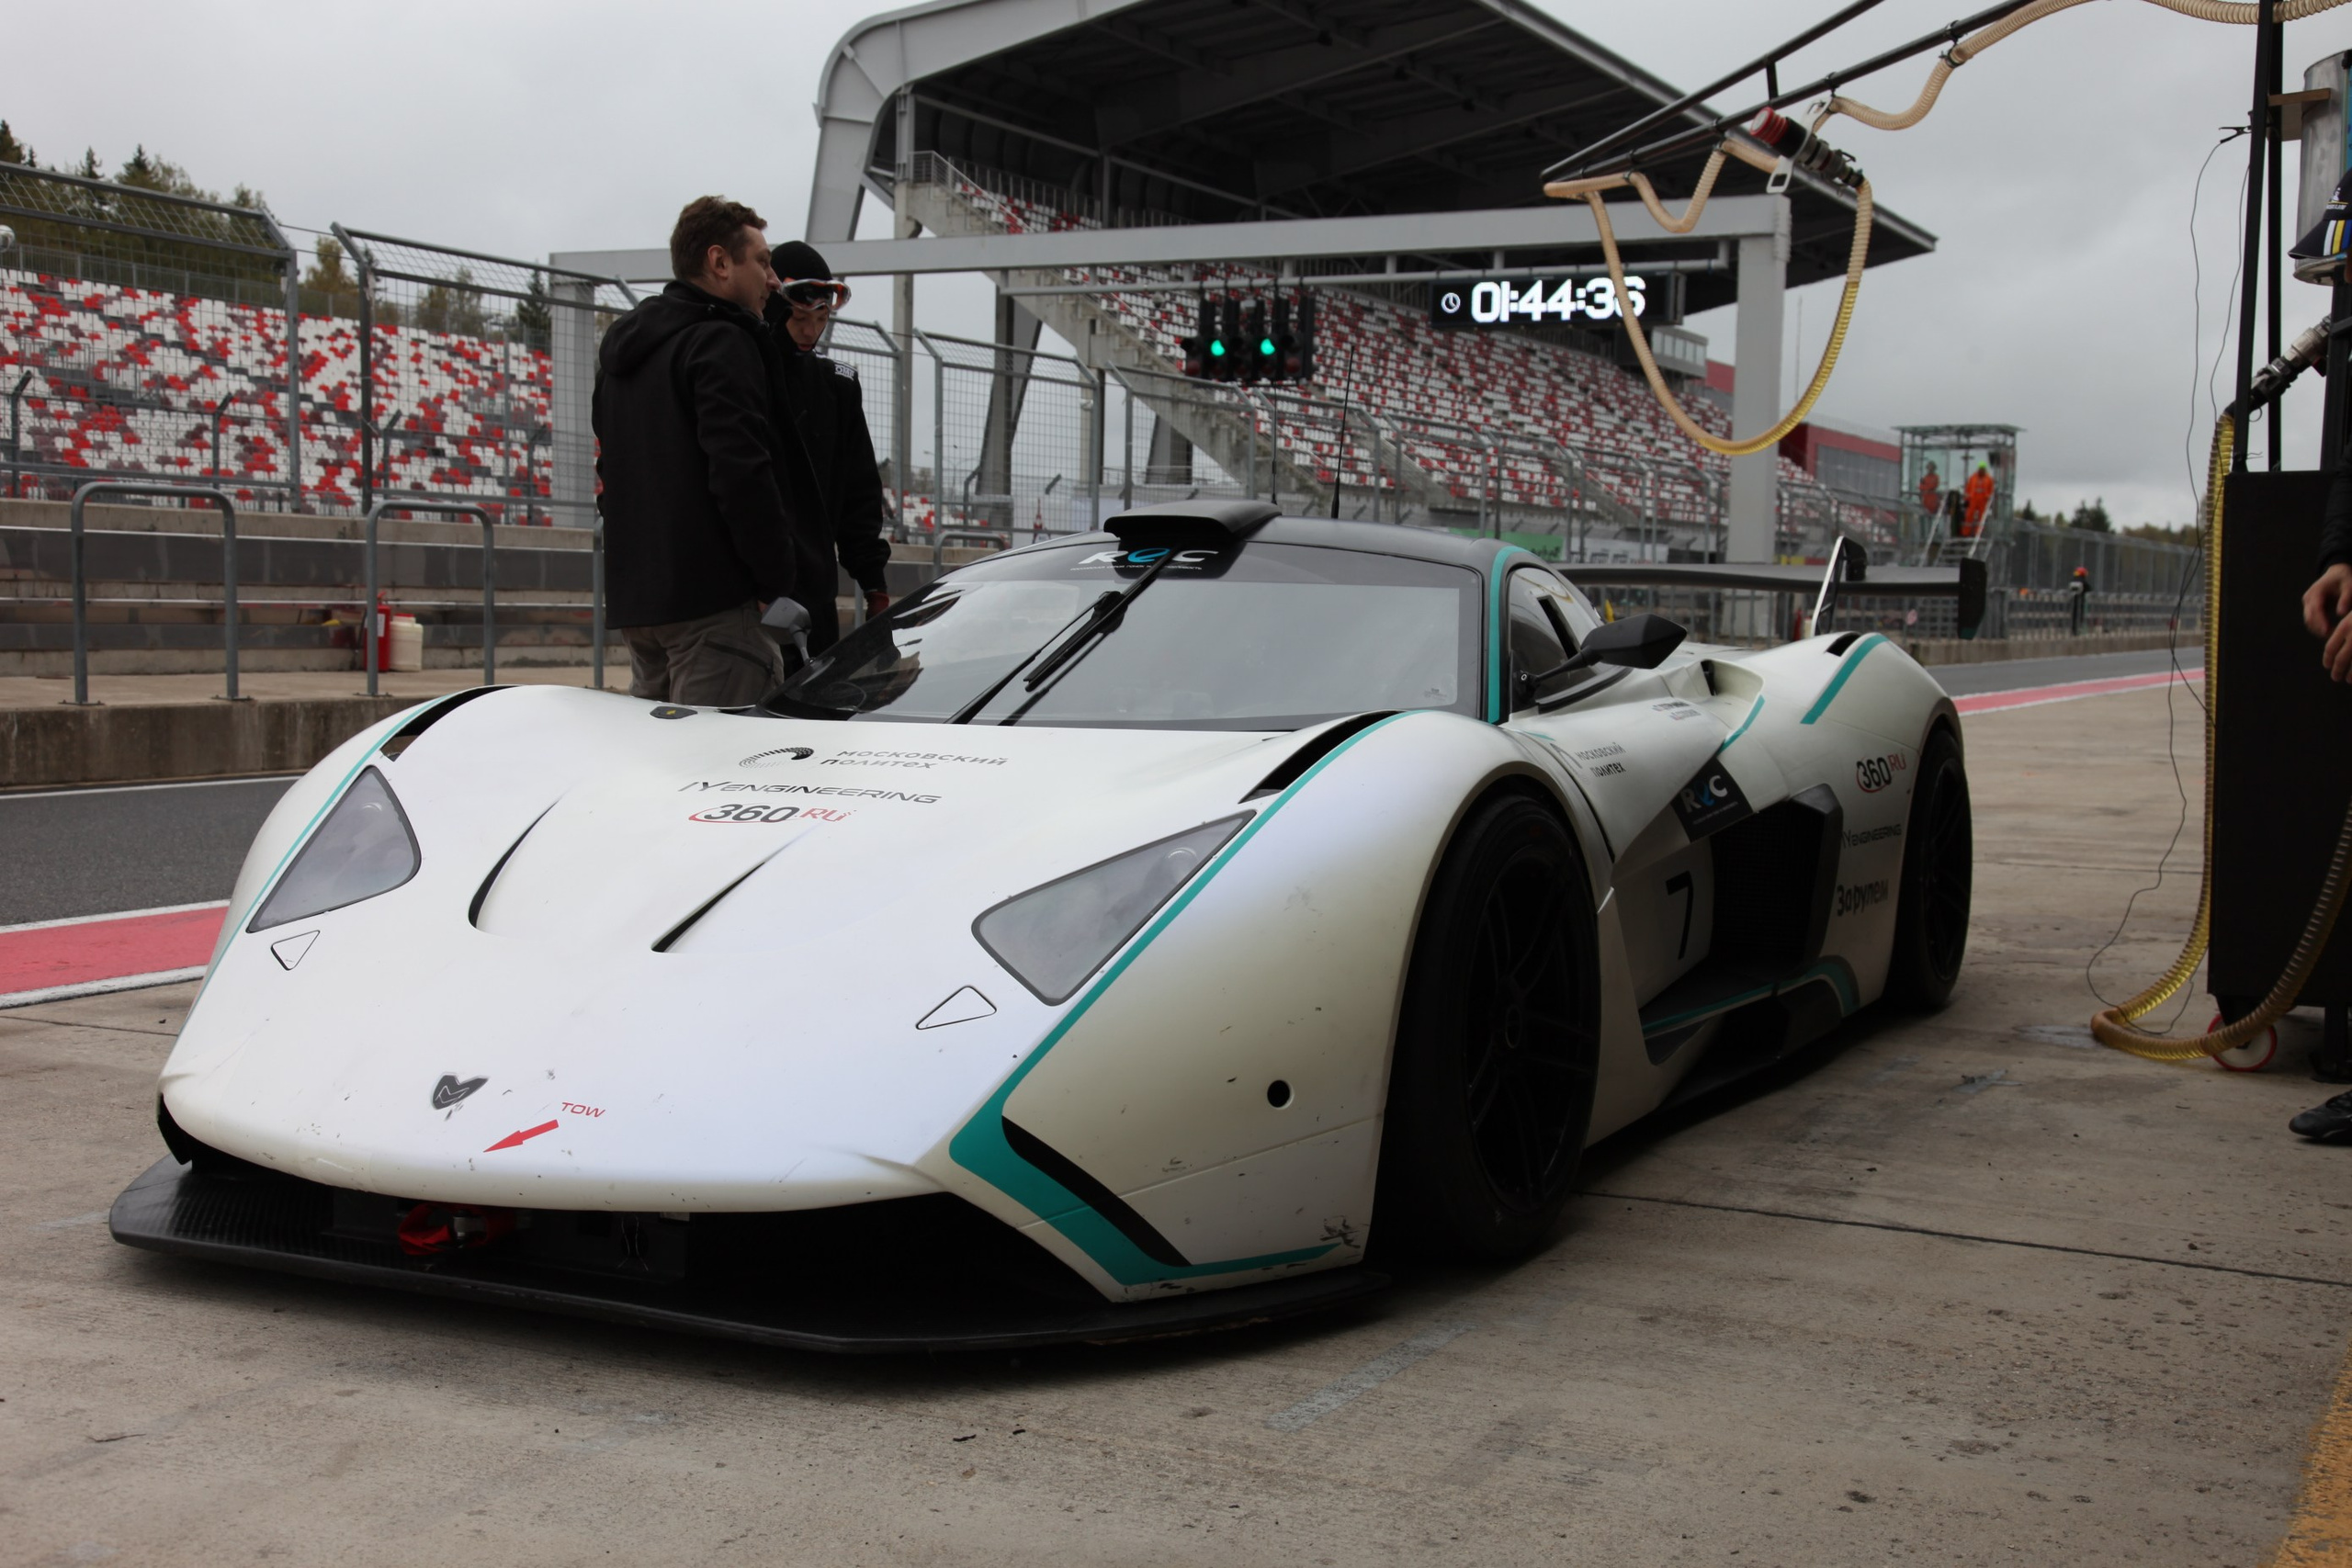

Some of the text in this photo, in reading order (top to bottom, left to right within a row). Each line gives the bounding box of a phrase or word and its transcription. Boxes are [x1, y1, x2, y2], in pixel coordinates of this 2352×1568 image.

[1471, 276, 1646, 322] 01:44:36
[837, 750, 1009, 766] МОСКОВСКИЙ
[1575, 742, 1626, 761] МОСКОВСКИЙ
[1666, 870, 1693, 961] 7
[561, 1101, 605, 1118] TOW
